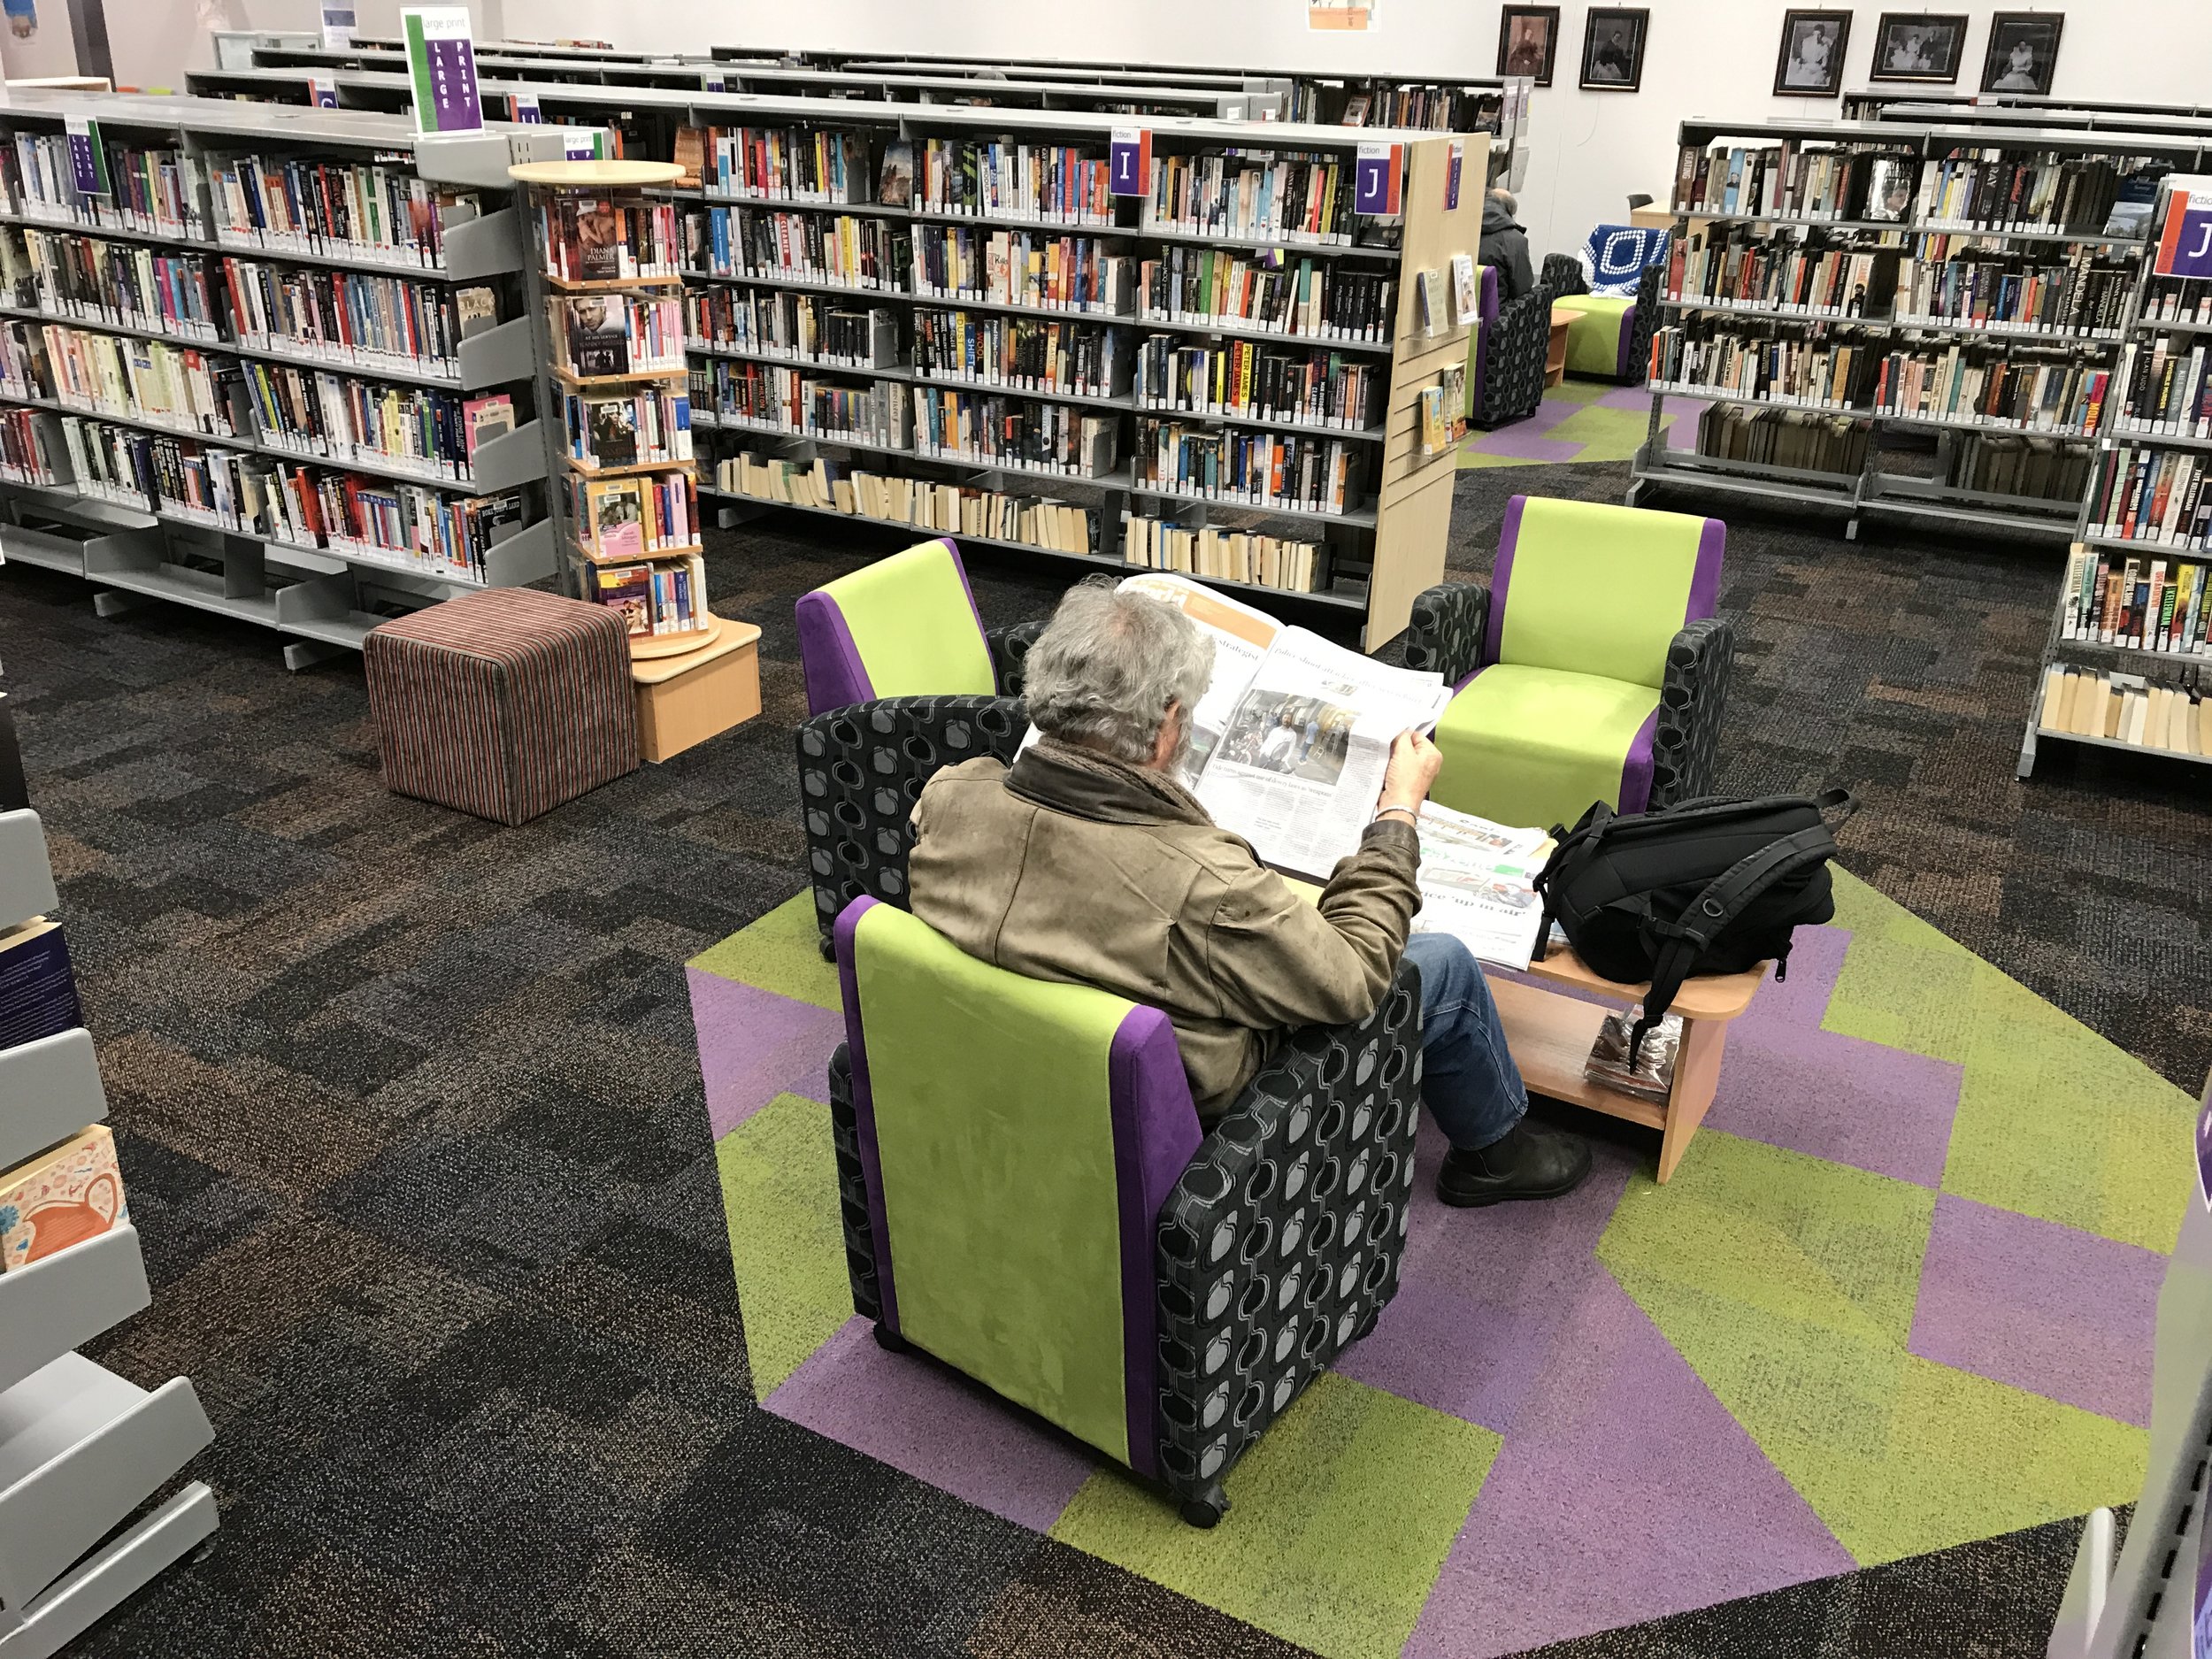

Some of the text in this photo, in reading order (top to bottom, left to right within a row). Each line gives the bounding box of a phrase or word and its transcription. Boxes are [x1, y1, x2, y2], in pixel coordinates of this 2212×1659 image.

[423, 18, 465, 30] large print
[434, 42, 449, 109] LARGE
[456, 42, 471, 108] PRINT
[1112, 129, 1132, 139] fiction
[1358, 145, 1380, 154] fiction
[982, 167, 991, 192] MODUS
[1119, 151, 1131, 180] I
[1682, 151, 1694, 180] KEATING
[1986, 165, 1999, 188] RAY
[1364, 168, 1379, 197] J
[2189, 194, 2212, 205] fictio
[780, 220, 790, 253] CLEANER
[2187, 222, 2212, 257] J
[587, 253, 616, 262] PALMER
[2070, 257, 2092, 317] MANDELA
[458, 296, 495, 311] BLACK
[2094, 291, 2108, 323] MANDELA
[2084, 402, 2099, 430] MOLLY
[2185, 469, 2201, 511] FAYE KELLERMAN
[2123, 568, 2138, 607] COMPULSION
[2161, 589, 2176, 626] KELLERMAN
[1217, 639, 1260, 662] strategist
